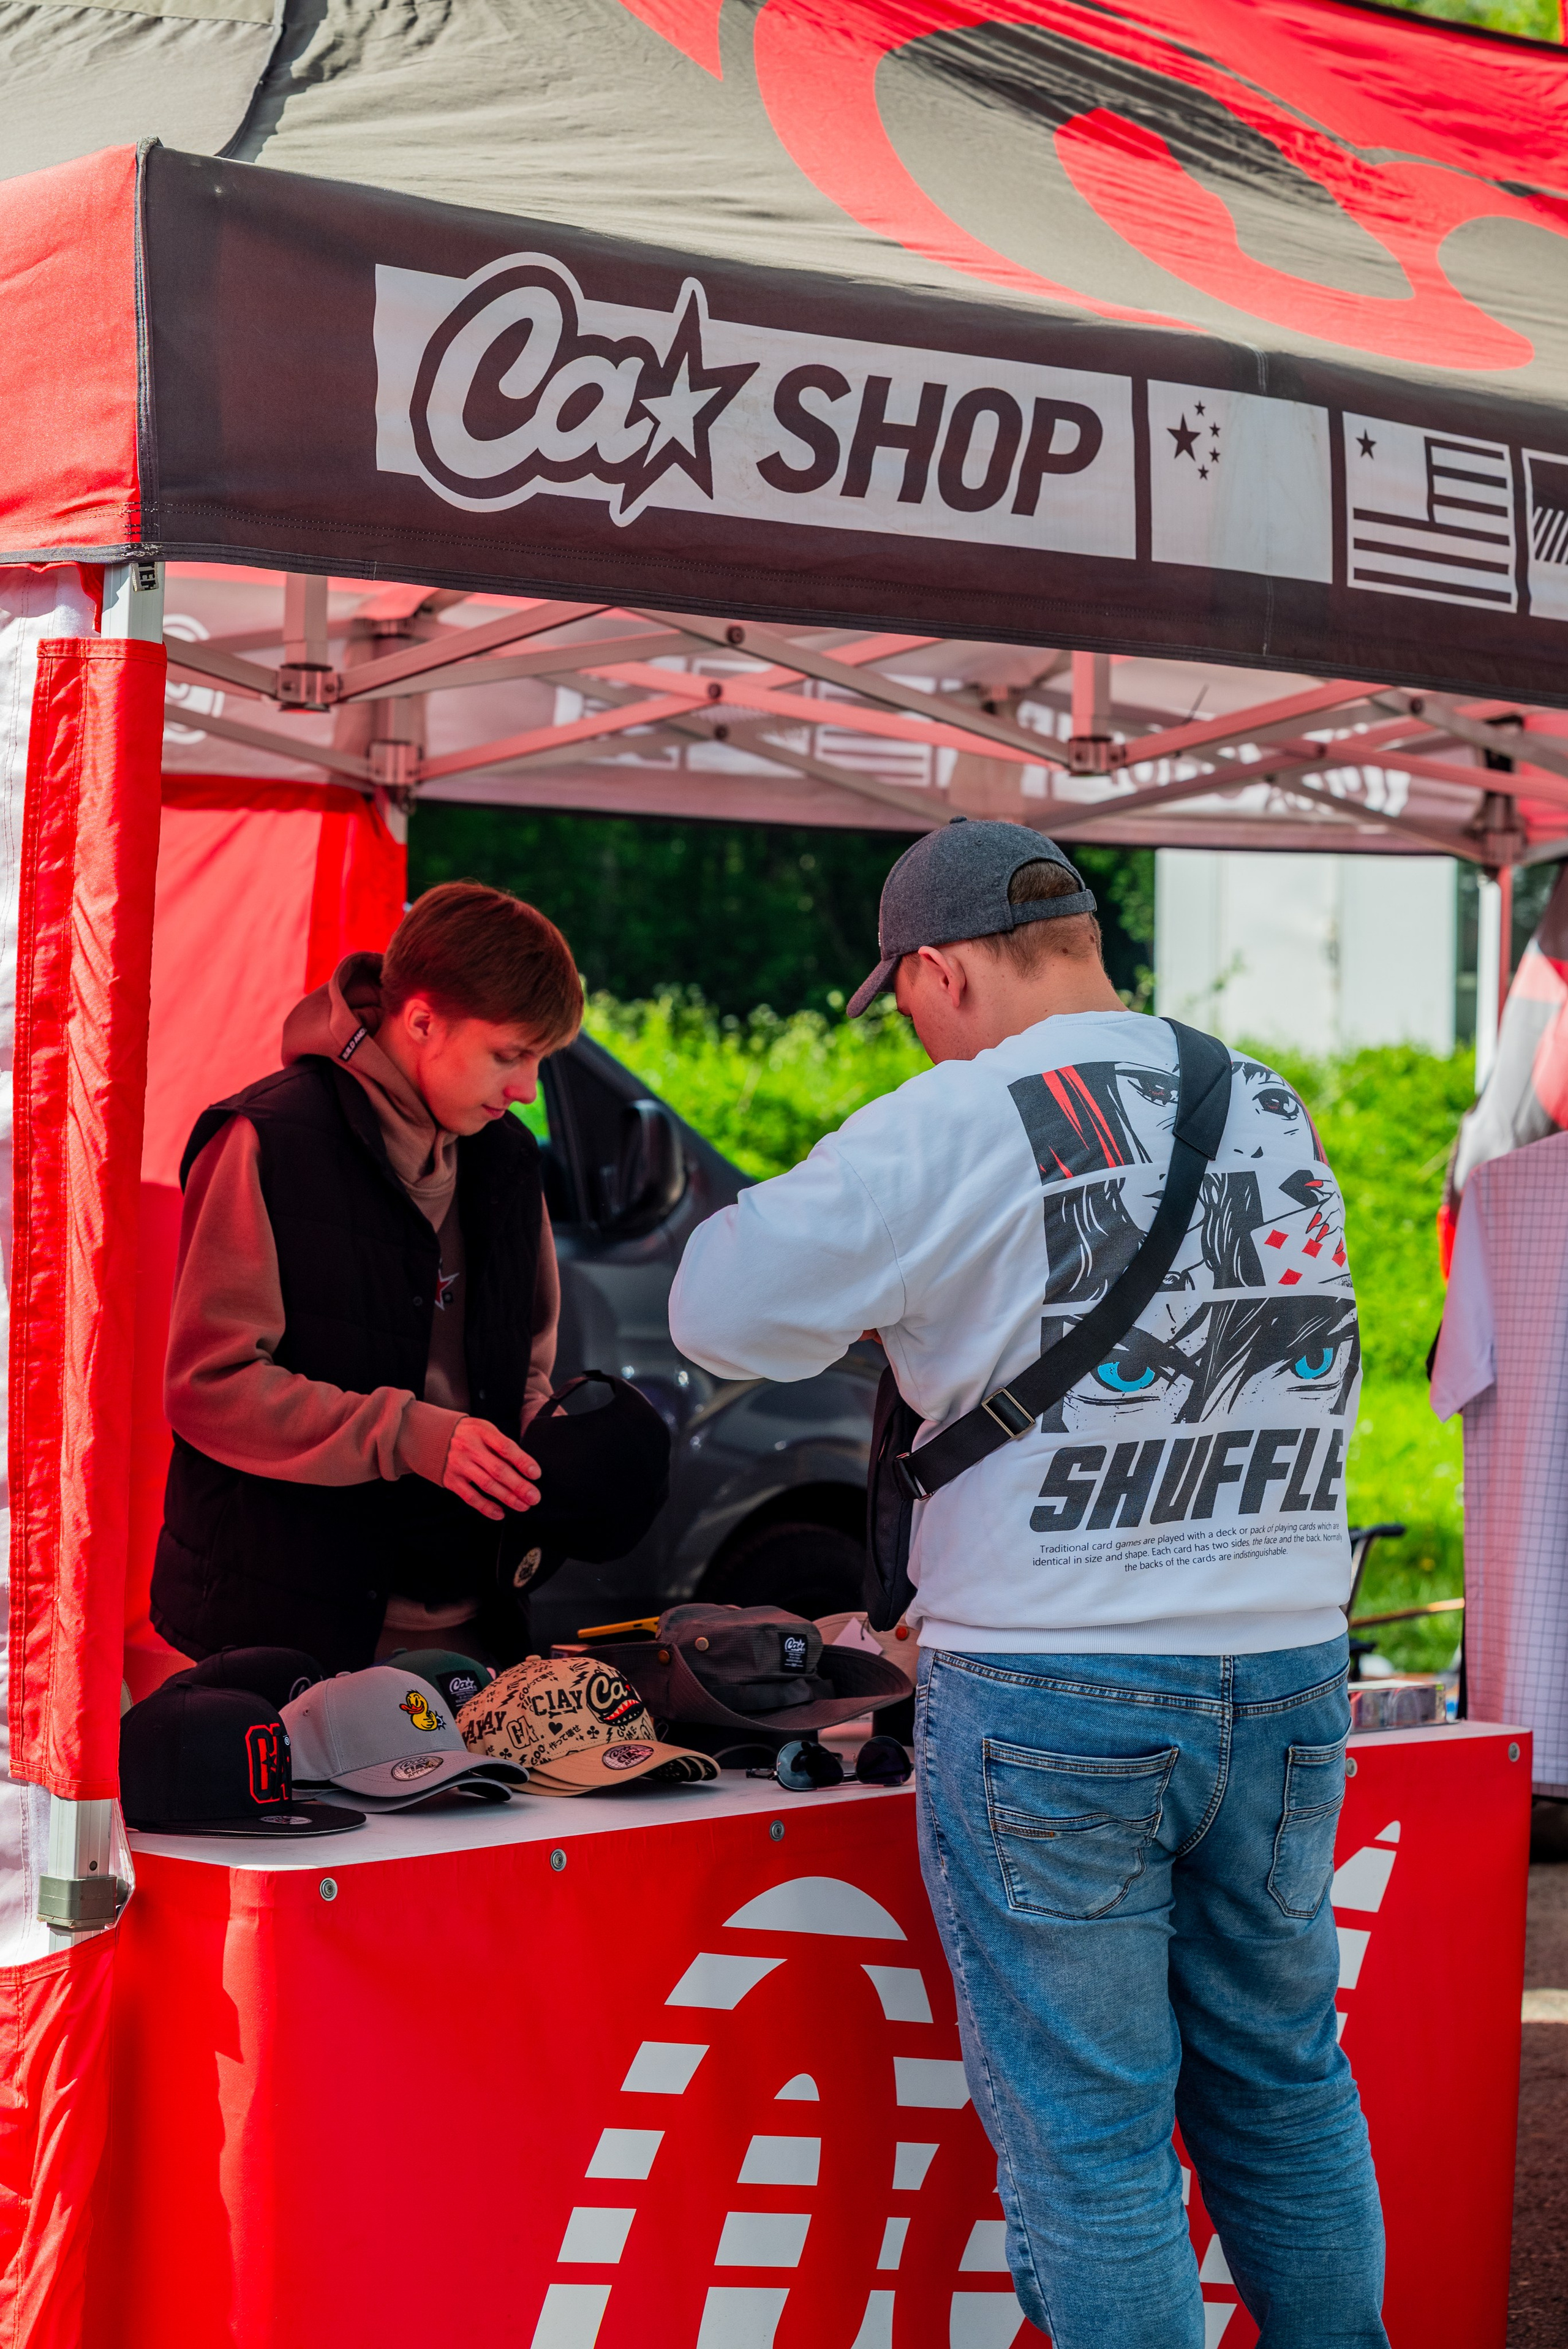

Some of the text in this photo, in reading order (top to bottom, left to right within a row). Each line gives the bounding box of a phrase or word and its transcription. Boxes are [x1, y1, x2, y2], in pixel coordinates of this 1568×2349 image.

[756, 364, 1103, 517] SHOP
[1030, 1428, 1344, 1533] SHUFFLE
[1033, 1556, 1070, 1566] identical
[1085, 1555, 1102, 1563] size
[1106, 1552, 1122, 1561] and
[1125, 1550, 1150, 1559] shape.
[1152, 1547, 1171, 1556] Each
[1174, 1544, 1192, 1553] card
[1195, 1544, 1210, 1553] has
[1231, 1538, 1251, 1547] sides,
[1252, 1537, 1262, 1546] the
[1306, 1533, 1322, 1542] back.
[1323, 1533, 1342, 1542] Normally
[1040, 1543, 1088, 1553] Traditional
[1092, 1540, 1112, 1550] card
[1115, 1539, 1140, 1551] games
[1158, 1533, 1185, 1545] played
[1187, 1531, 1205, 1540] with
[1216, 1527, 1237, 1537] deck
[1250, 1525, 1266, 1536] pack
[1267, 1524, 1275, 1533] of
[1275, 1523, 1297, 1533] playing
[1299, 1522, 1316, 1531] cards
[1125, 1563, 1137, 1572] the
[1140, 1559, 1163, 1569] backs
[1166, 1558, 1174, 1566] of
[1193, 1554, 1216, 1564] cards
[1234, 1547, 1289, 1559] indistinguishable.
